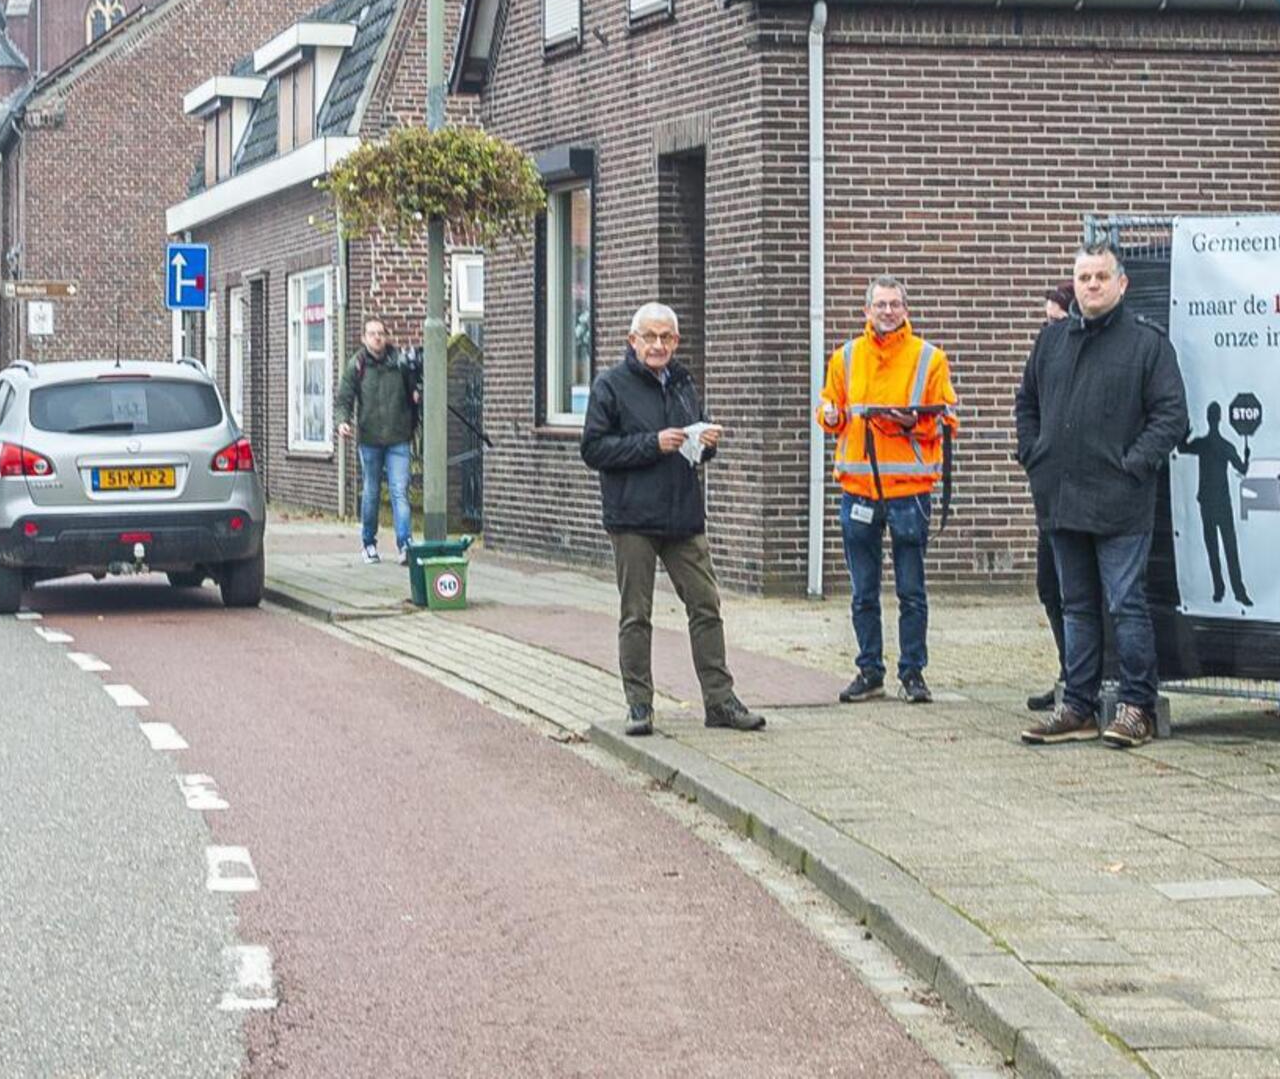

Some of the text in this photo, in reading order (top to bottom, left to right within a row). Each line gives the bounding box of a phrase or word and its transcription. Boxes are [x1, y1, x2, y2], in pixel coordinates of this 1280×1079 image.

[1188, 299, 1236, 316] maar
[1243, 294, 1268, 315] de
[1213, 329, 1259, 348] onze
[1232, 407, 1260, 420] STOP
[439, 579, 457, 591] 50
